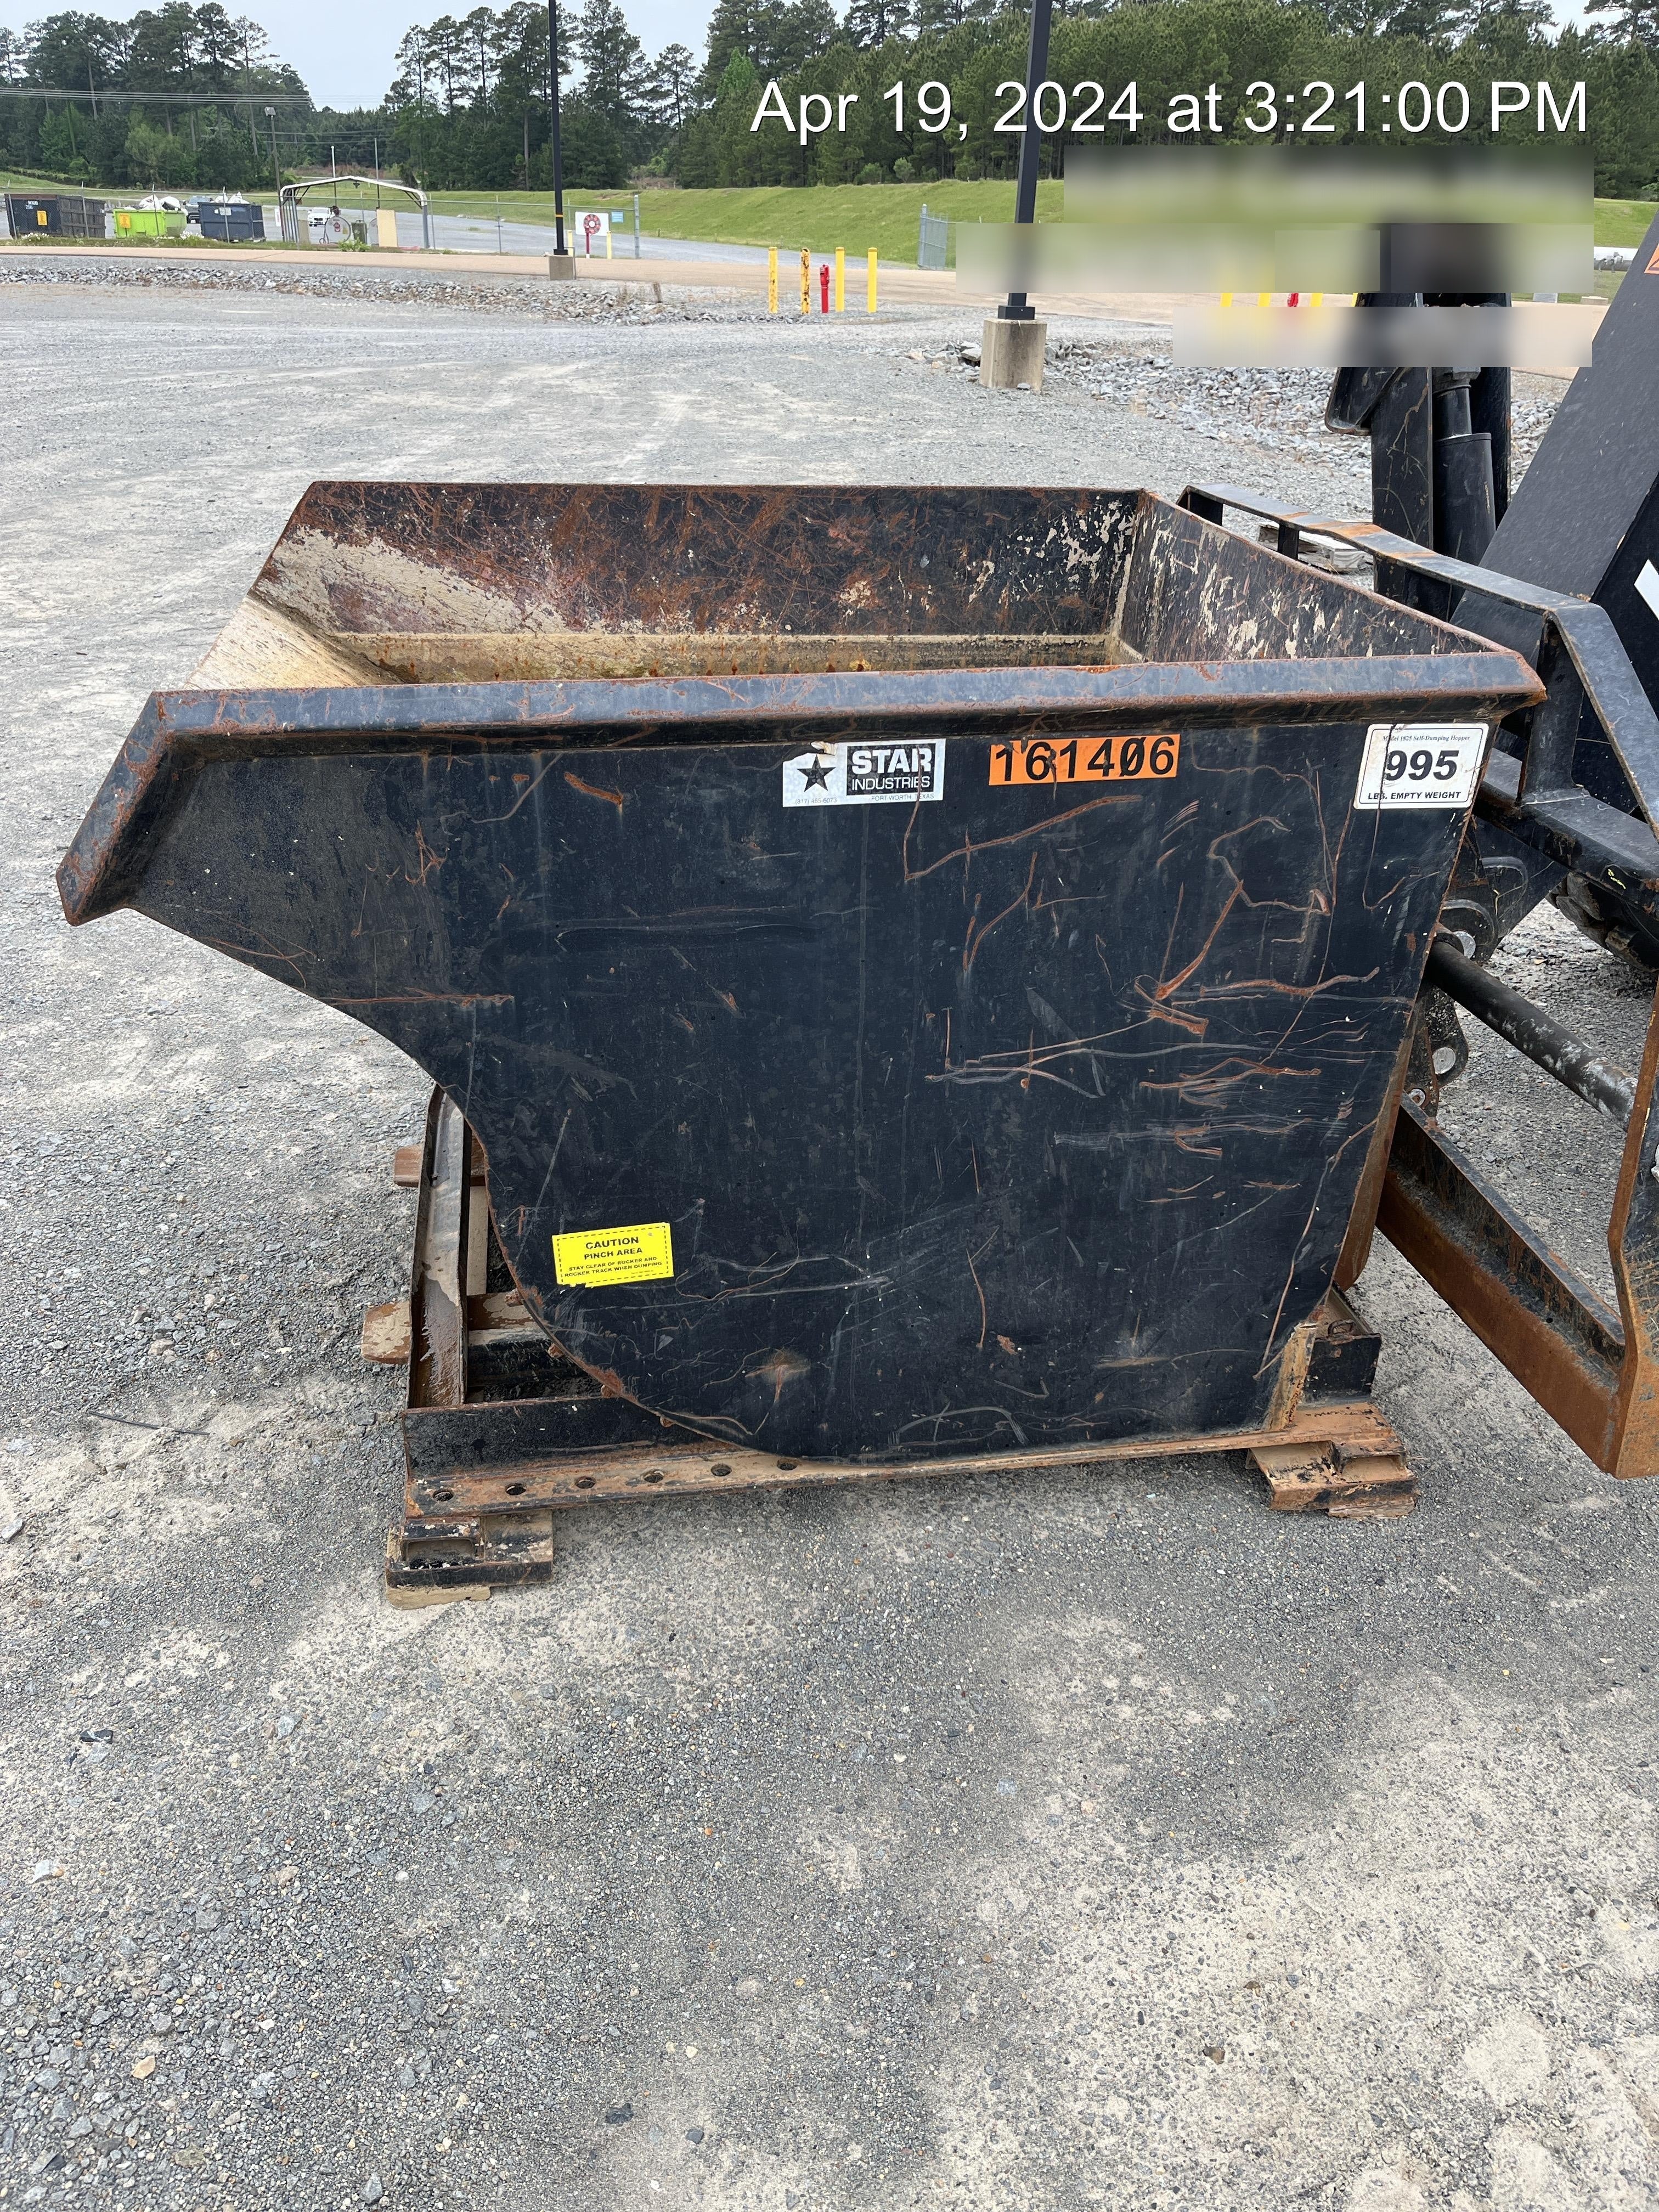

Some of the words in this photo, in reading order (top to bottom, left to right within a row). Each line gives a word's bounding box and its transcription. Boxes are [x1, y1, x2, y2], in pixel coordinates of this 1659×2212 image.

[852, 748, 932, 775] STAR
[1385, 749, 1459, 781] 995
[851, 776, 930, 791] INDUSTRIES
[585, 1236, 639, 1249] CAUTION
[584, 1250, 614, 1260] PINCH
[617, 1247, 643, 1256] AREA
